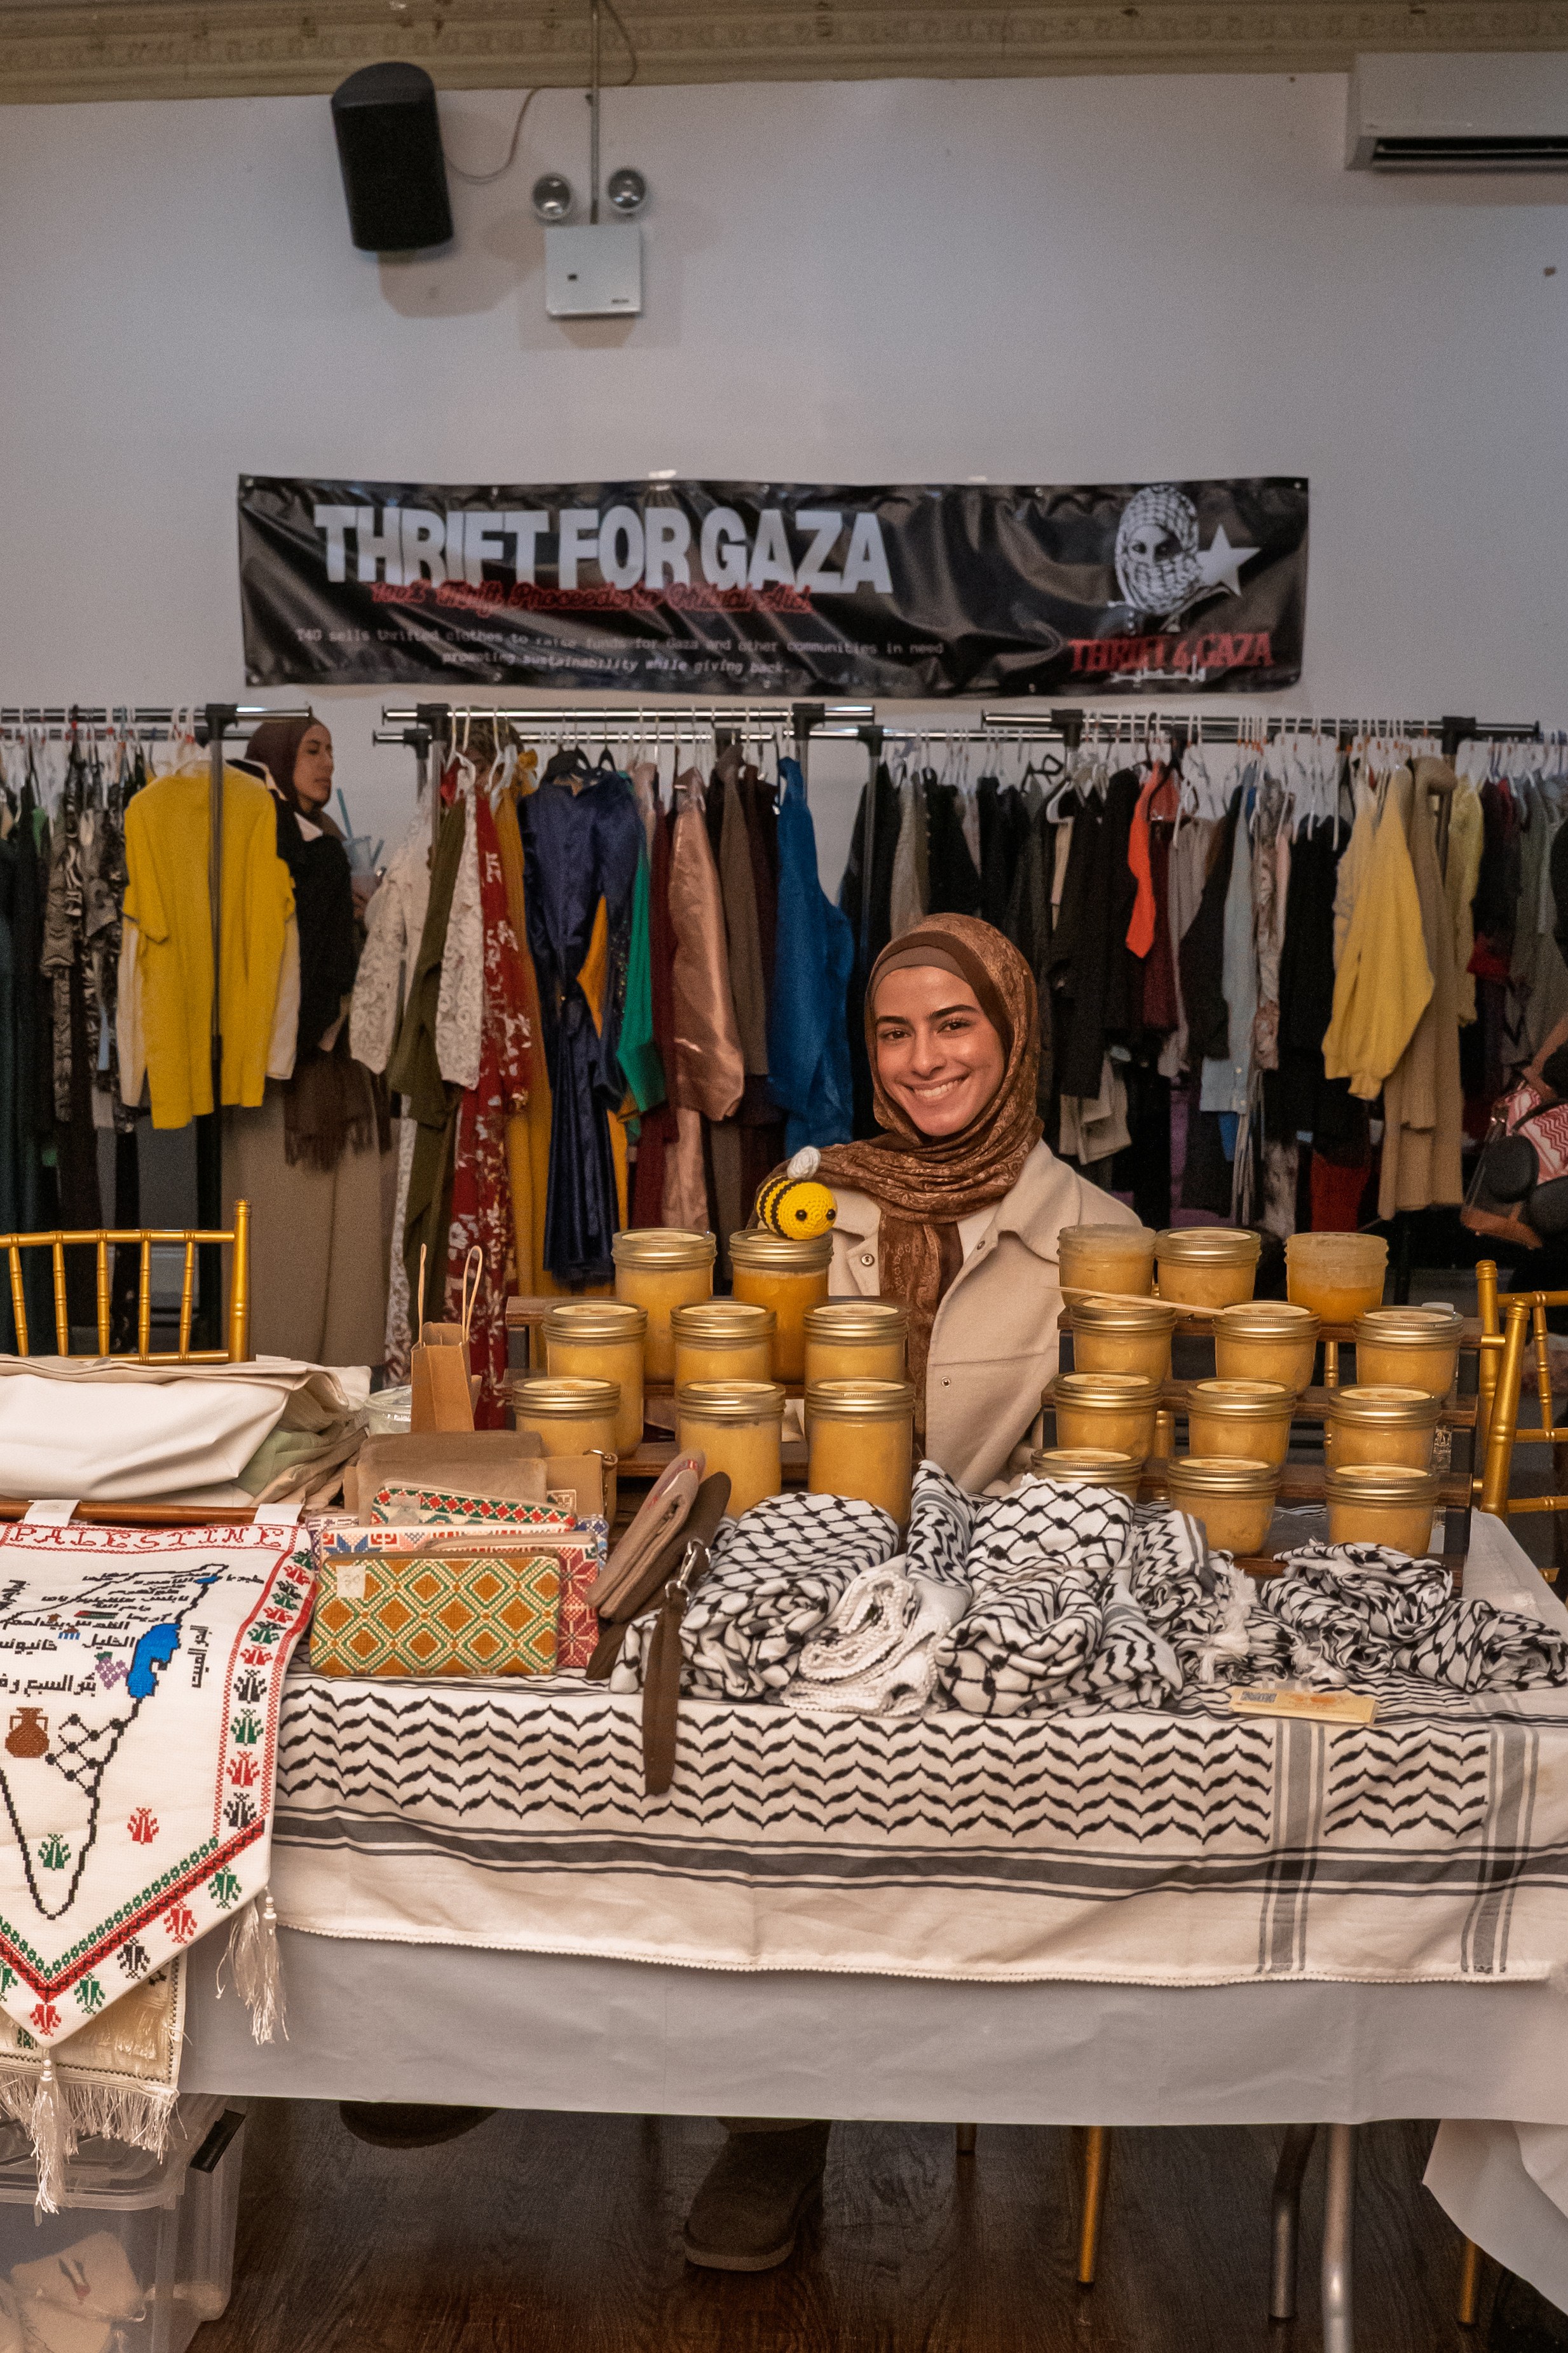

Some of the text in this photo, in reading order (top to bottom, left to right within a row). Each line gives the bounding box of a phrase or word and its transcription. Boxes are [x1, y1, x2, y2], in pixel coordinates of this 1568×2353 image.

[314, 504, 894, 594] THRIFT FOR GAZA
[329, 628, 371, 642] sells
[377, 628, 440, 642] thrifted
[446, 628, 503, 643] clothes
[511, 633, 533, 645] to
[535, 637, 578, 647] raise
[586, 636, 628, 648] funds
[636, 637, 657, 649] for
[667, 638, 699, 650] Gaza
[706, 640, 732, 652] and
[738, 640, 777, 652] other
[787, 641, 878, 655] communities
[887, 642, 903, 654] in
[910, 642, 945, 654] need
[443, 652, 517, 666] promoting
[522, 655, 638, 673] sustainability
[644, 657, 688, 671] while
[694, 661, 742, 675] giving
[1068, 633, 1275, 674] THRIFT 4 GAZA
[10, 1526, 285, 1549] PALESTINE
[39, 1620, 64, 1630] بيت
[66, 1620, 131, 1631] القدس
[81, 1633, 136, 1650] الخليل
[187, 1647, 210, 1688] الميت
[0, 1672, 20, 1694] رف
[24, 1674, 74, 1698] السبع
